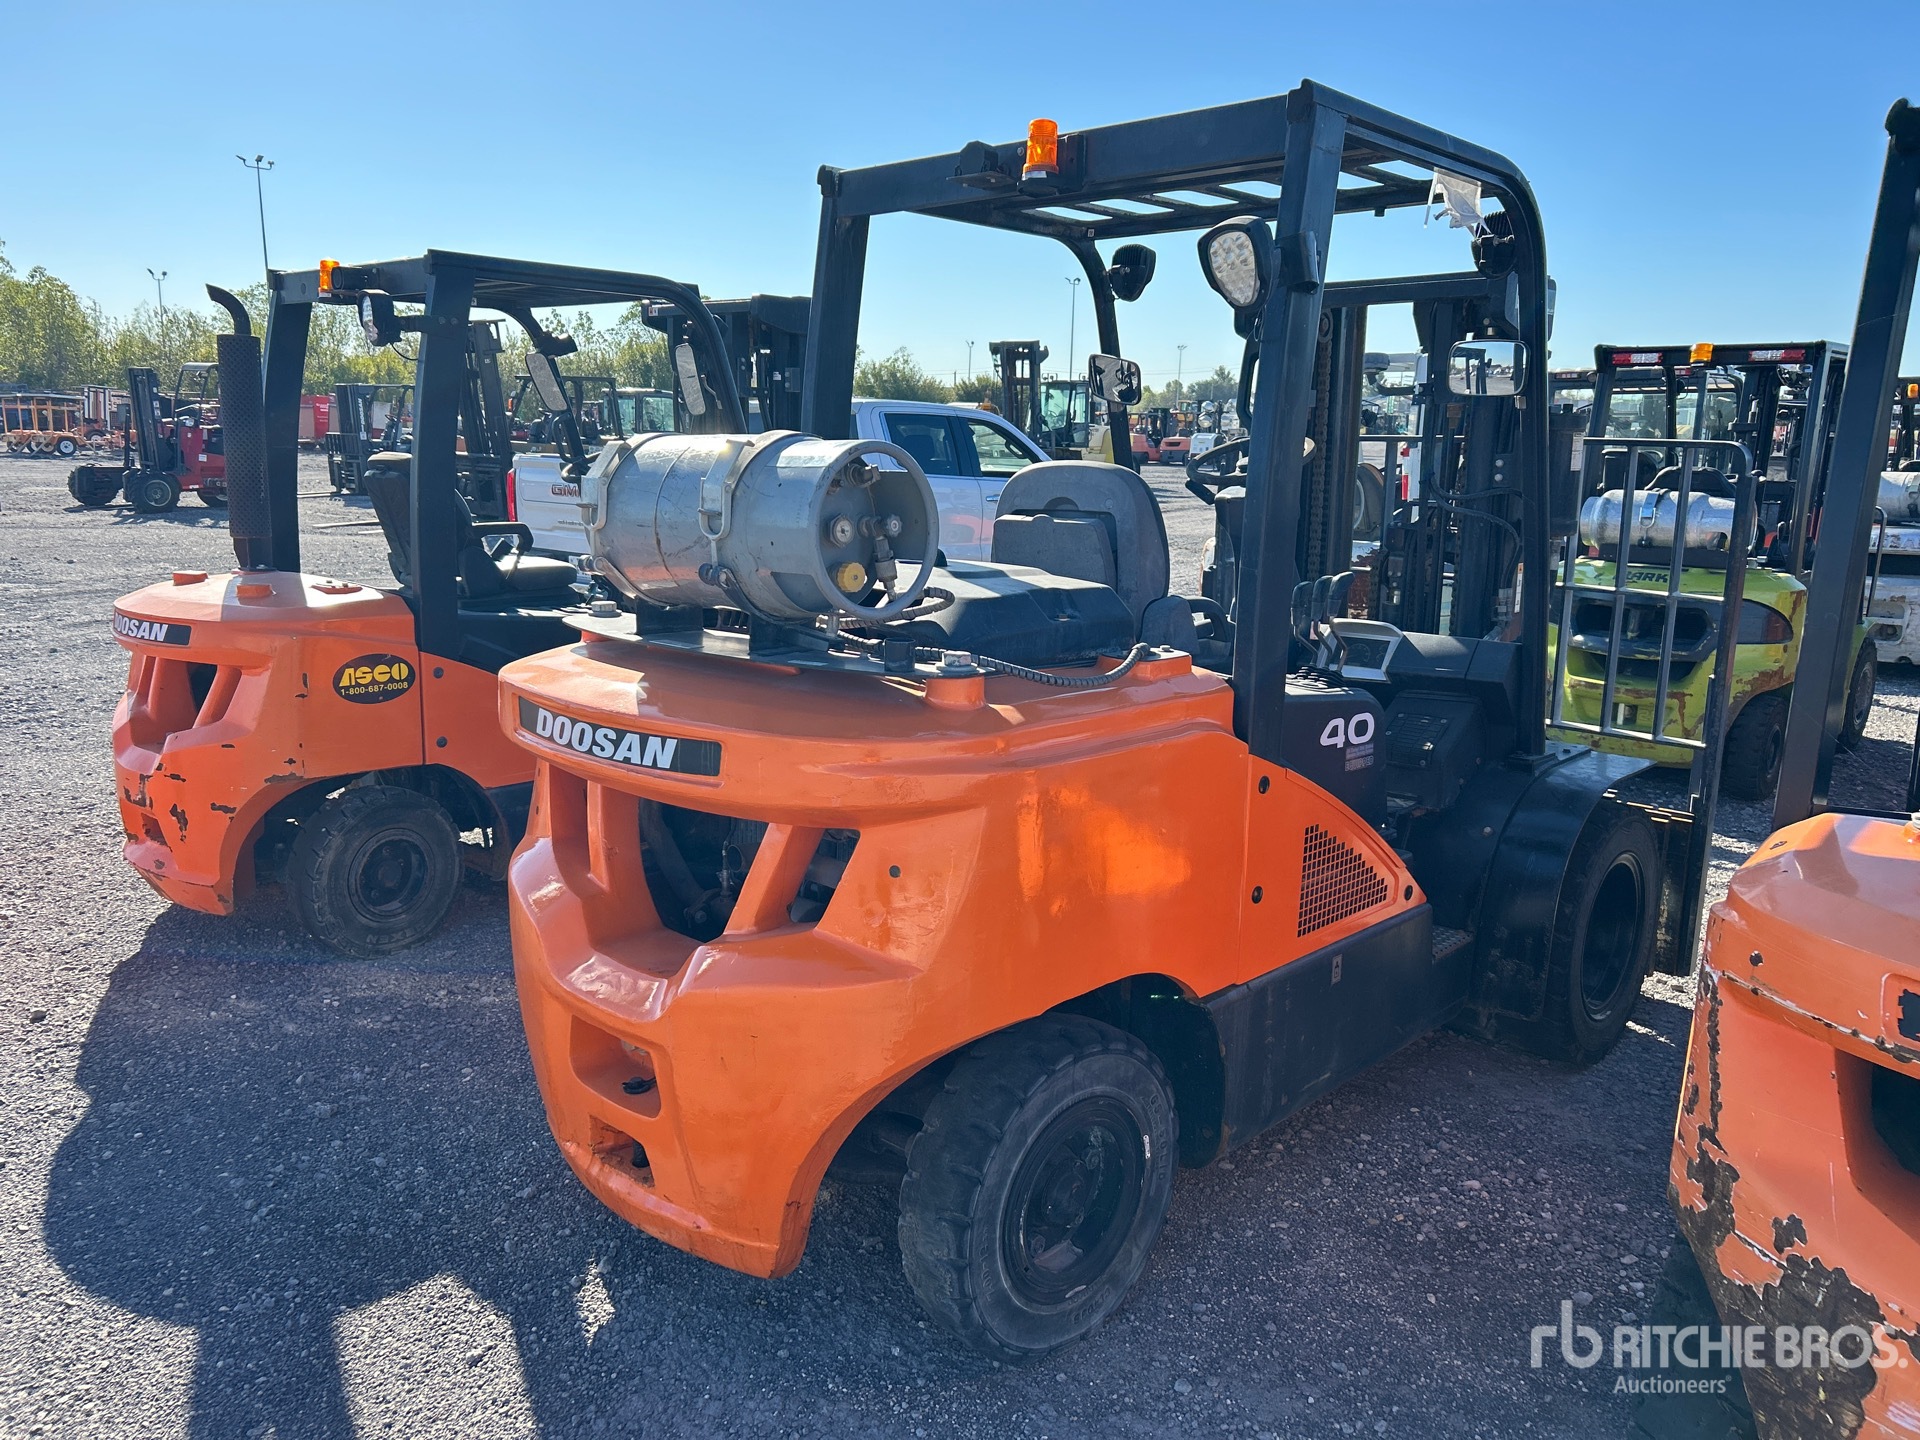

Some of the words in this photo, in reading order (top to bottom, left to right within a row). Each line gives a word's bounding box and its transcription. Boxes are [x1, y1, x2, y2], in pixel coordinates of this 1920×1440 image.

[551, 484, 580, 497] GM
[1613, 570, 1669, 583] LARK
[339, 662, 409, 687] ASCO
[340, 682, 408, 696] 1-800-687-0008
[536, 707, 678, 769] DOOSAN
[1319, 712, 1375, 749] 40
